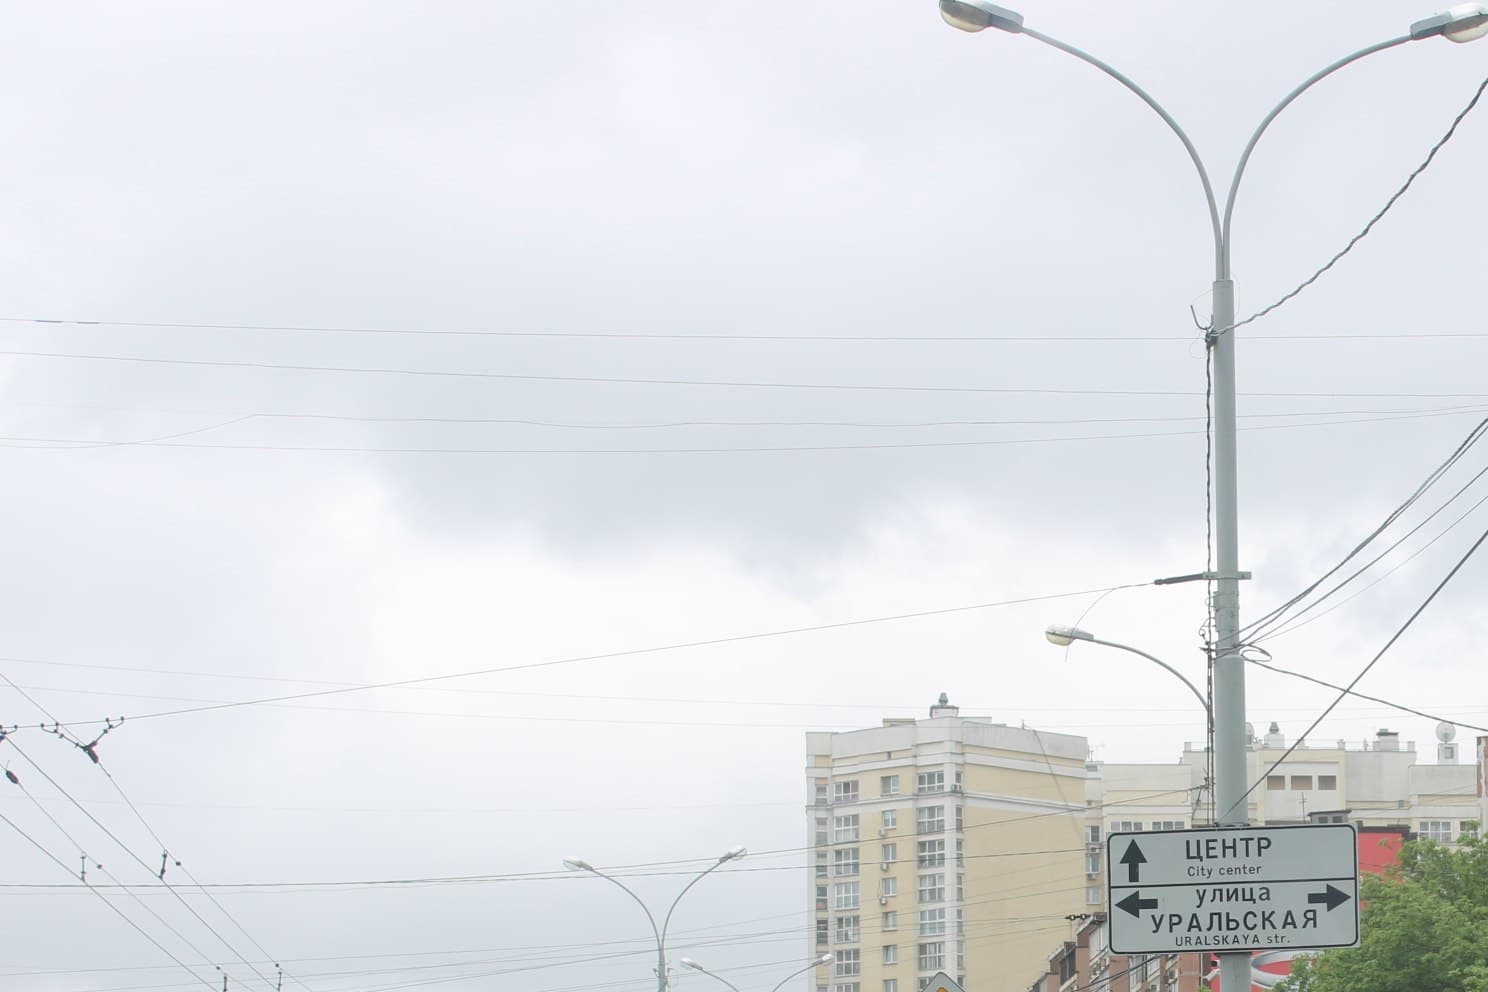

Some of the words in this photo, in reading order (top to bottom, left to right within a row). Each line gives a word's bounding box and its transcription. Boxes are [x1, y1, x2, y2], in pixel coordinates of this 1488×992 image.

[1185, 837, 1272, 862] ЦЕНТР
[1187, 866, 1213, 879] City
[1219, 865, 1262, 876] center
[1196, 886, 1271, 908] улица
[1151, 909, 1318, 933] УРАЛЬСКАЯ
[1175, 934, 1260, 947] URALSKAYA
[1267, 933, 1291, 944] str.
